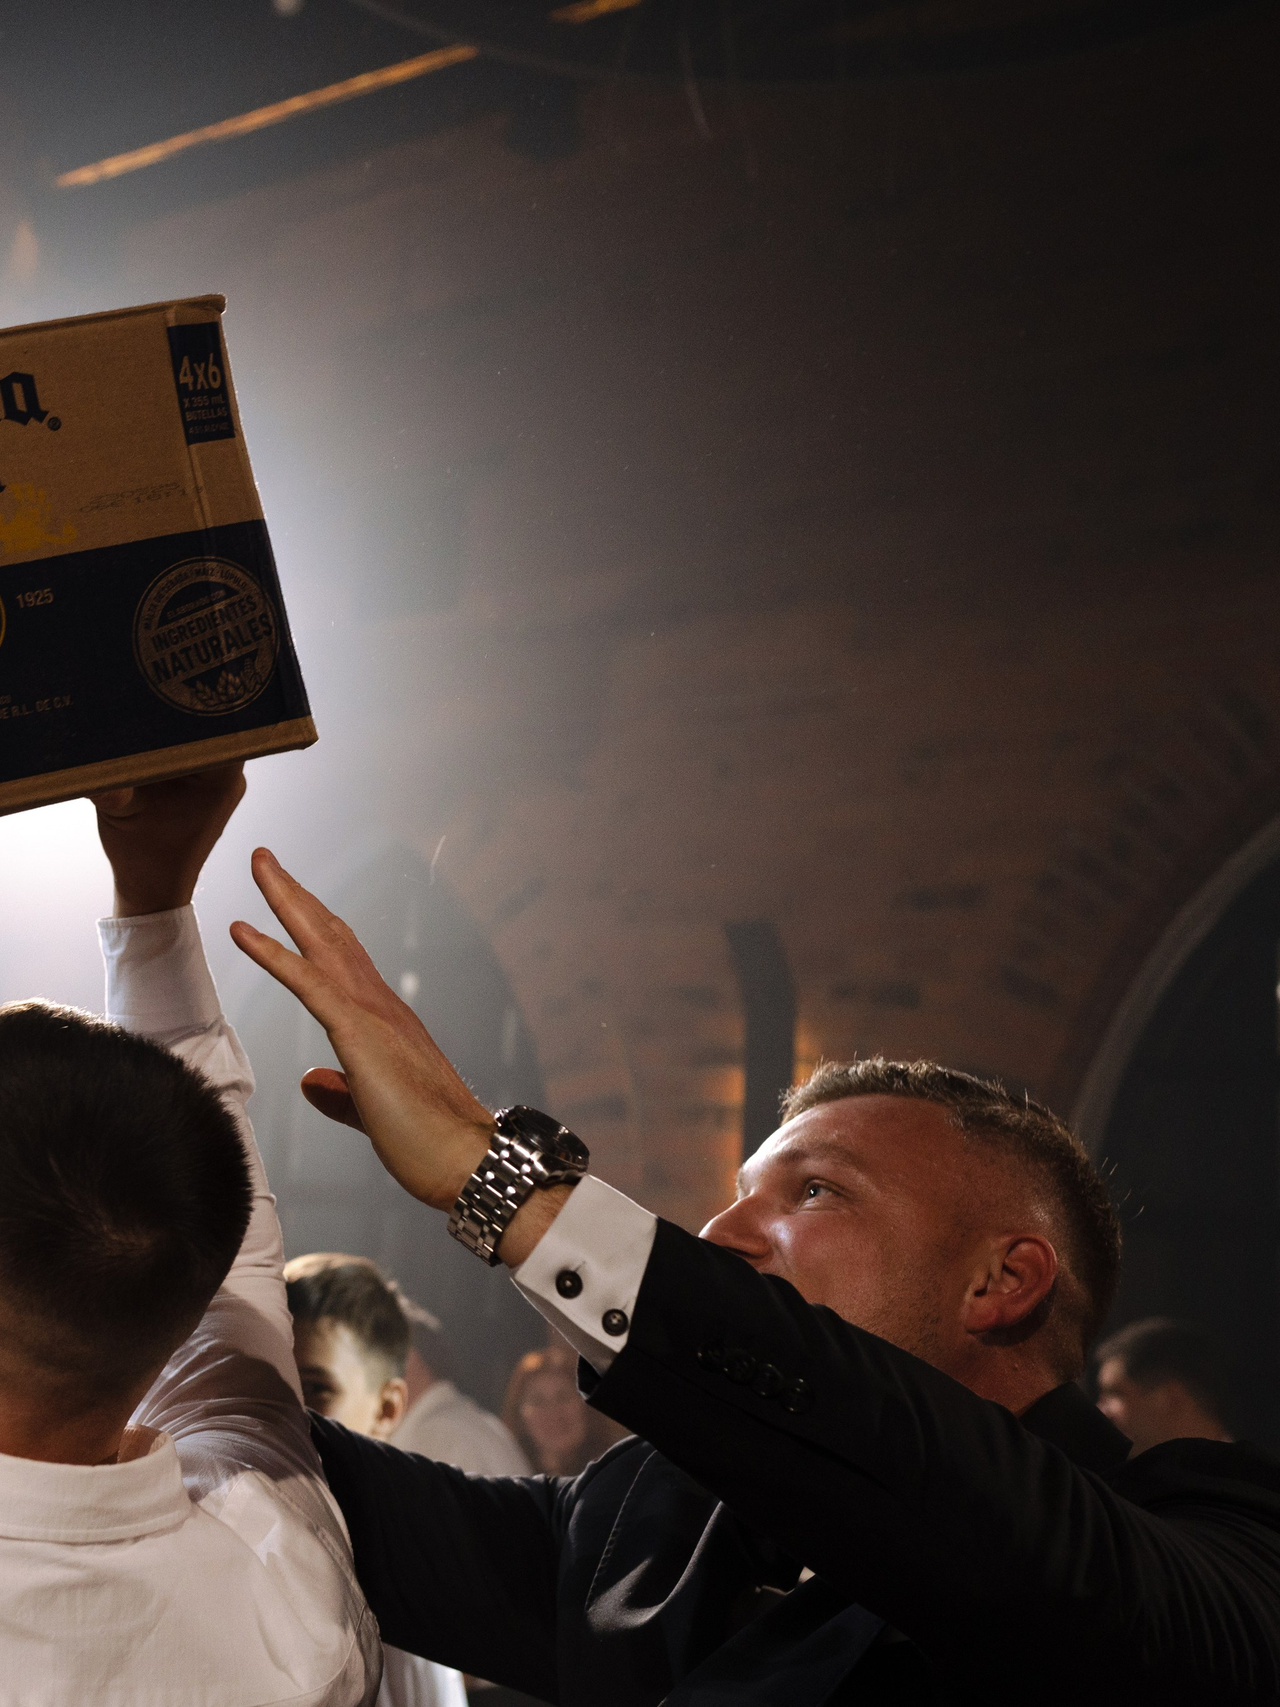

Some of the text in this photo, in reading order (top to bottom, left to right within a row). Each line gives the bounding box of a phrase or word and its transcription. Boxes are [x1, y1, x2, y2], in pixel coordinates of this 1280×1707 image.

[16, 587, 55, 609] 1925
[152, 594, 258, 652] INGREDIENTES
[151, 613, 272, 683] NATURALES
[35, 698, 52, 713] DE
